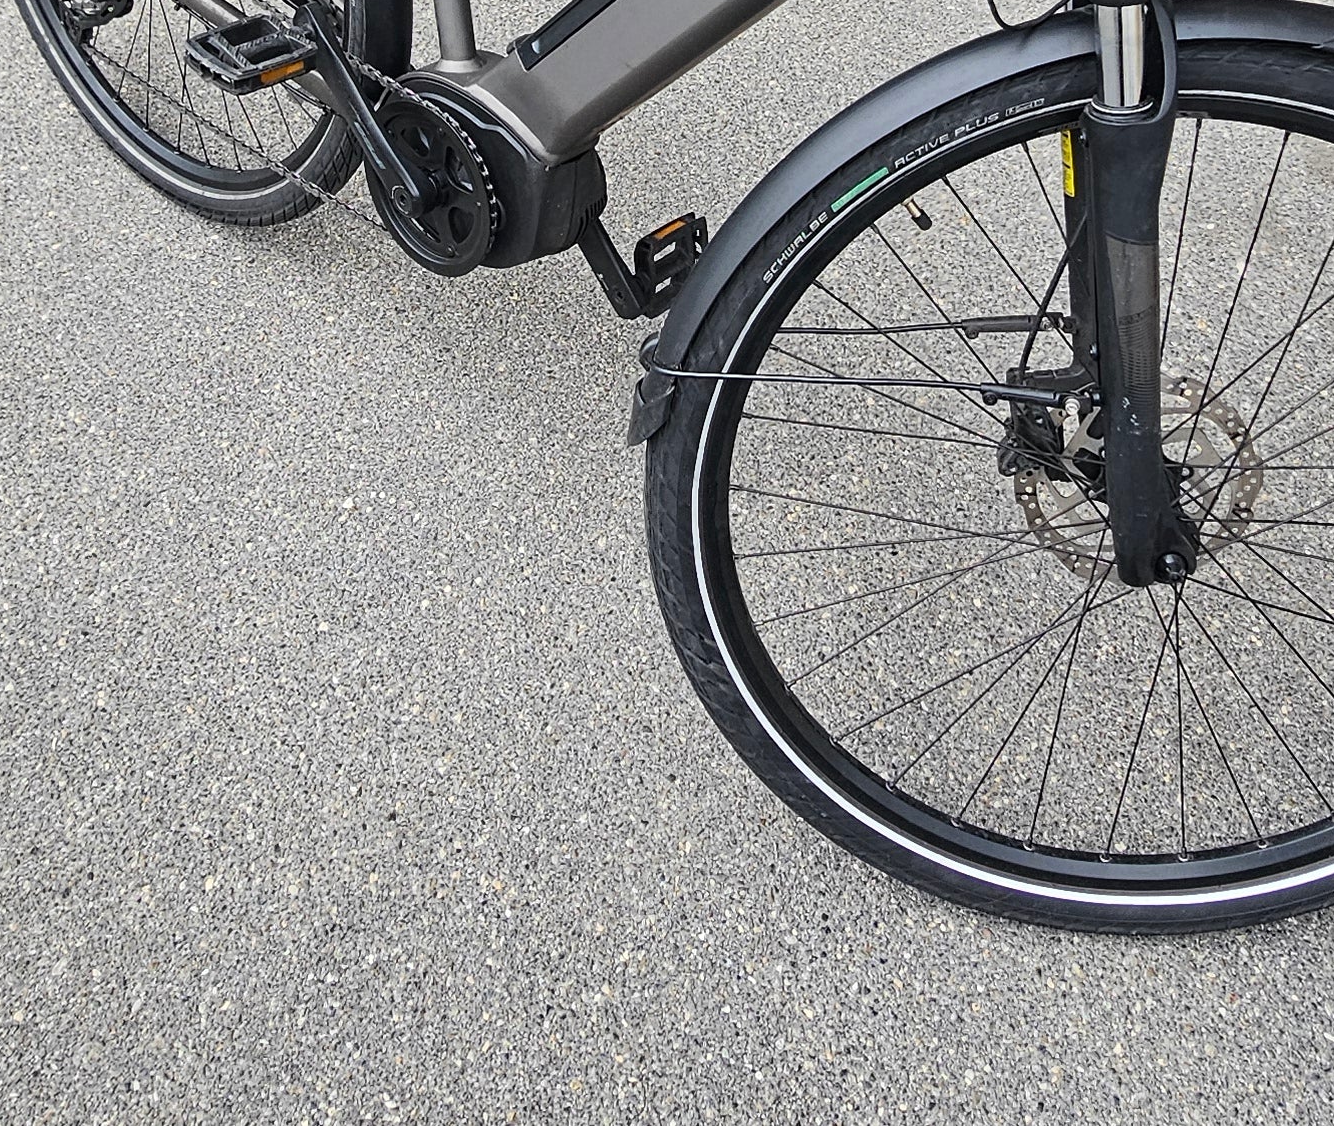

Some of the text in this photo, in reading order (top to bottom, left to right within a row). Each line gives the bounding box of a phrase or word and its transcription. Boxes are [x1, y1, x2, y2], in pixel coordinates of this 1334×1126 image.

[763, 112, 999, 284] SCHWALBE ACTIVE PLUS
